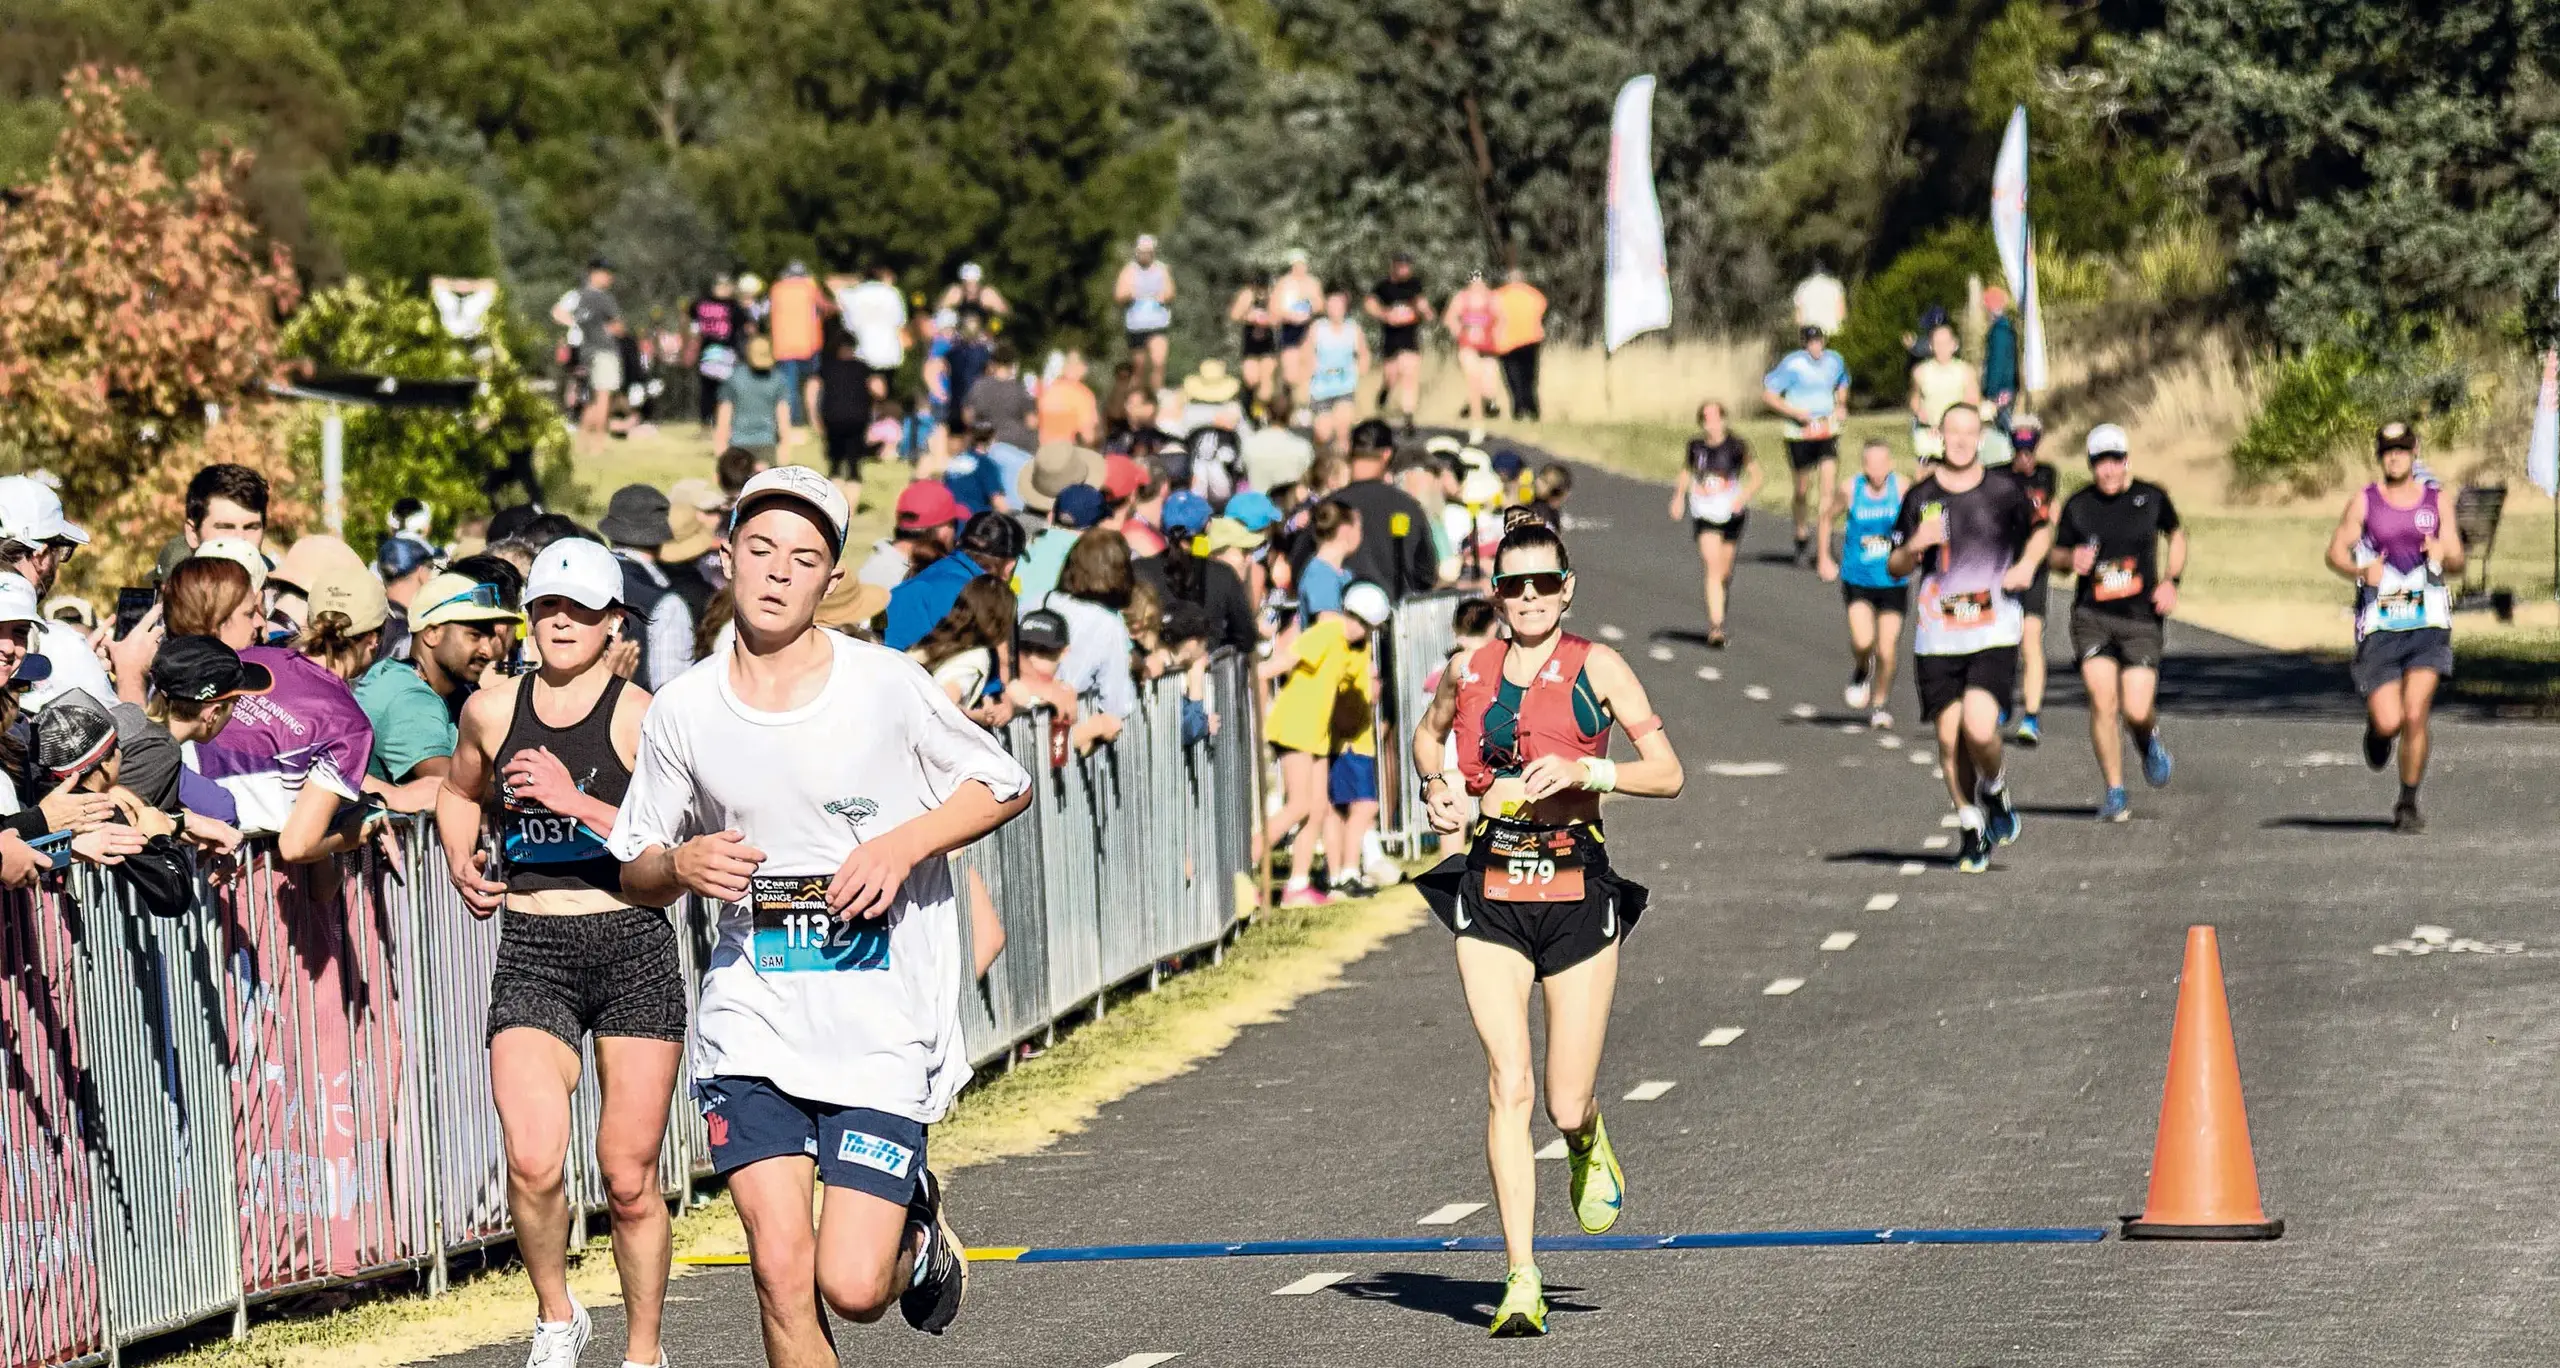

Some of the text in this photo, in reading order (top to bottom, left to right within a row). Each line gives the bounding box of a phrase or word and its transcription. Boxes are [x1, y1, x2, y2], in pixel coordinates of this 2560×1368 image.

[232, 707, 257, 727] 2025
[236, 698, 272, 726] ESTIVAL
[256, 695, 306, 736] RUNNING
[518, 817, 577, 845] 1037
[756, 879, 773, 890] OC
[785, 881, 799, 889] CITY
[1507, 859, 1556, 886] 579
[755, 893, 792, 901] ORANGE
[783, 913, 851, 949] 1132
[761, 956, 784, 967] SAM
